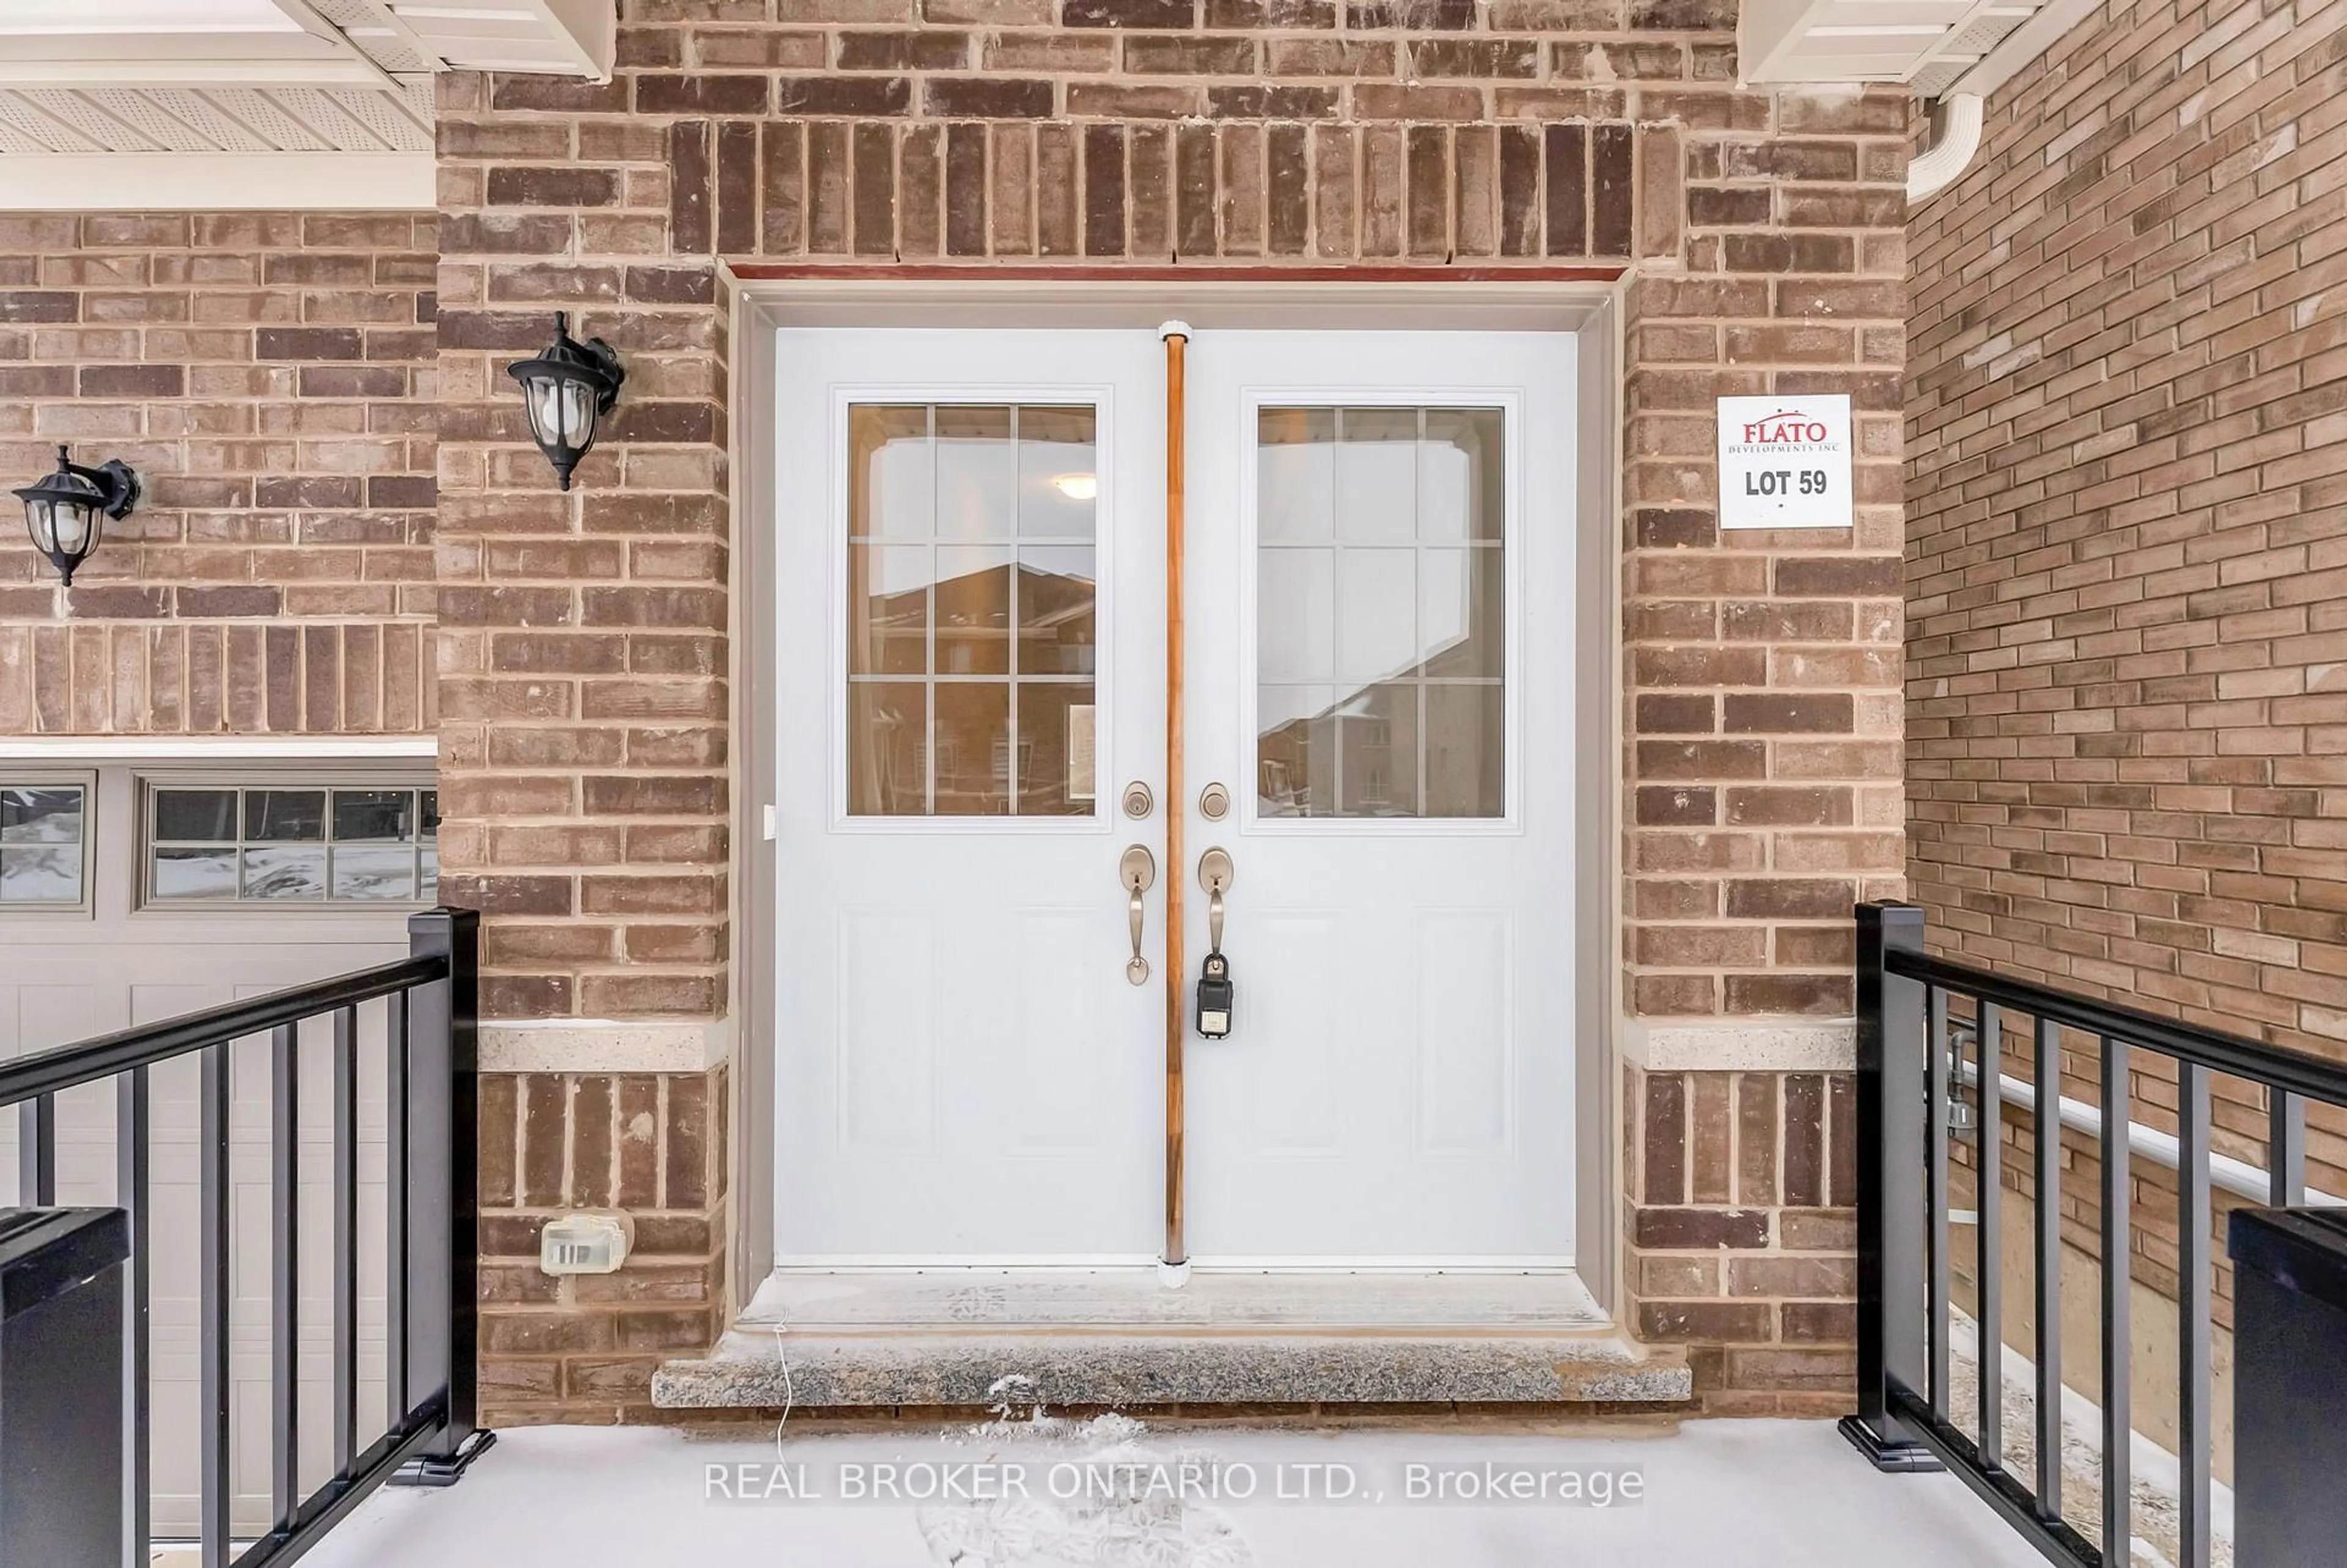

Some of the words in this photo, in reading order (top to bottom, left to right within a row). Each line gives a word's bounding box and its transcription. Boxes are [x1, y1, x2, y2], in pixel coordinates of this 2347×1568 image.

[1743, 422, 1827, 443] FLATO
[1728, 445, 1813, 453] DEVELOPMENTS
[1746, 471, 1791, 496] LOT
[1799, 470, 1827, 494] 59
